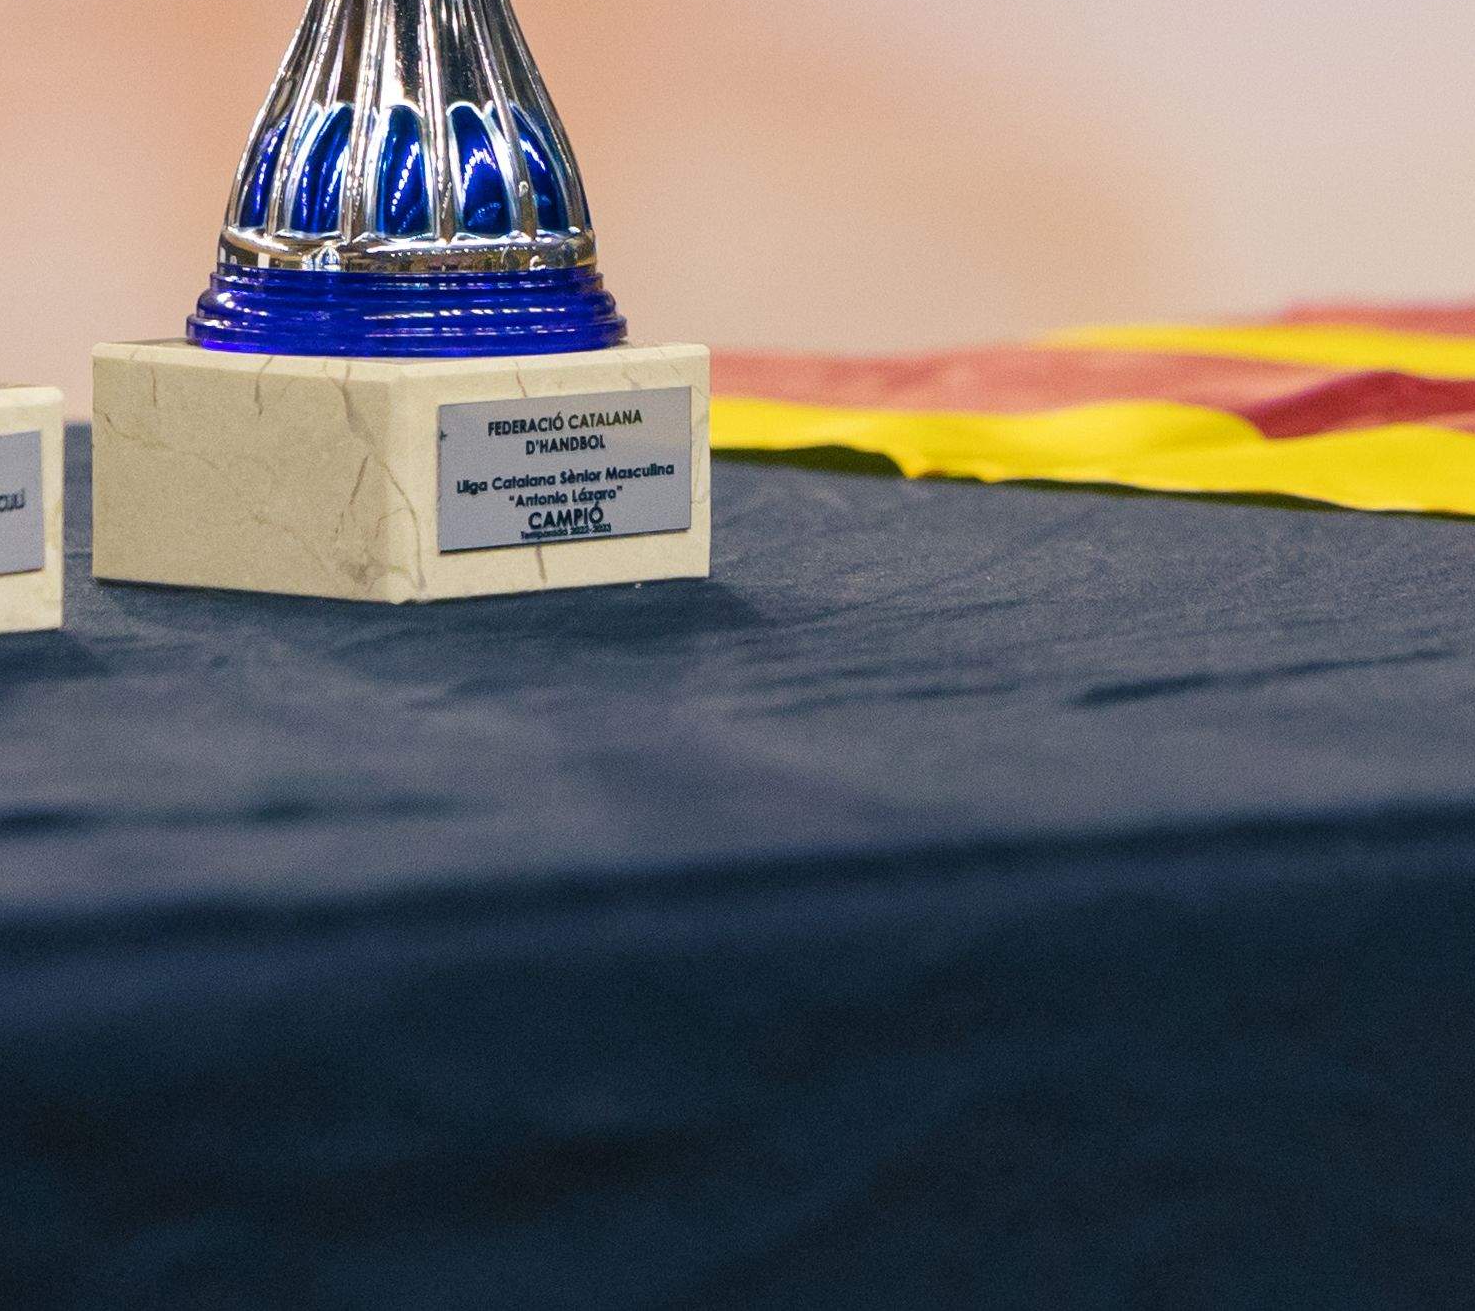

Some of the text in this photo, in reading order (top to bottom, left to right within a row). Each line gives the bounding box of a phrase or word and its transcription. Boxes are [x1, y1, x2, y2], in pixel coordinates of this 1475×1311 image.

[488, 409, 643, 437] FEDERACIÓ CATALANA
[526, 435, 606, 455] D'HANDBOL
[492, 473, 556, 491] Catalana
[560, 468, 602, 485] Sènior
[605, 462, 675, 480] Masculina
[528, 501, 604, 530] CAMPIÓ
